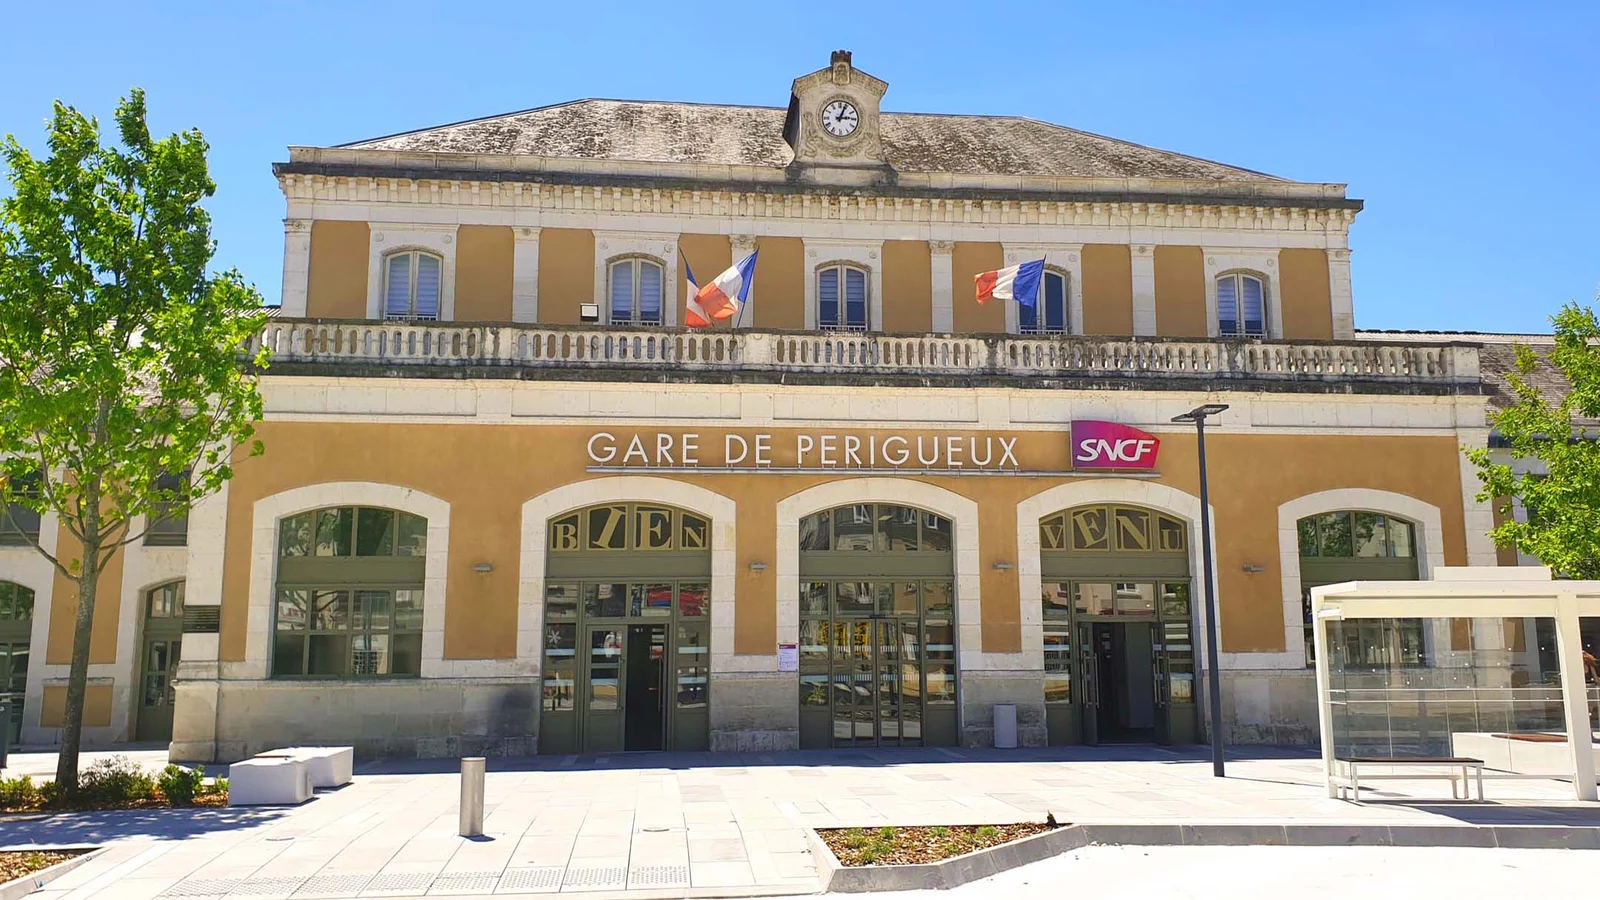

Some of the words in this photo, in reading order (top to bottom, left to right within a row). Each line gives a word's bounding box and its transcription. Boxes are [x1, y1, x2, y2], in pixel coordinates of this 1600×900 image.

[587, 432, 699, 463] GARE
[725, 434, 771, 464] DE
[797, 435, 1019, 466] PERIGUEUX
[1076, 438, 1155, 462] SNCF
[553, 506, 706, 550] BIEN
[1041, 508, 1181, 551] VENU
